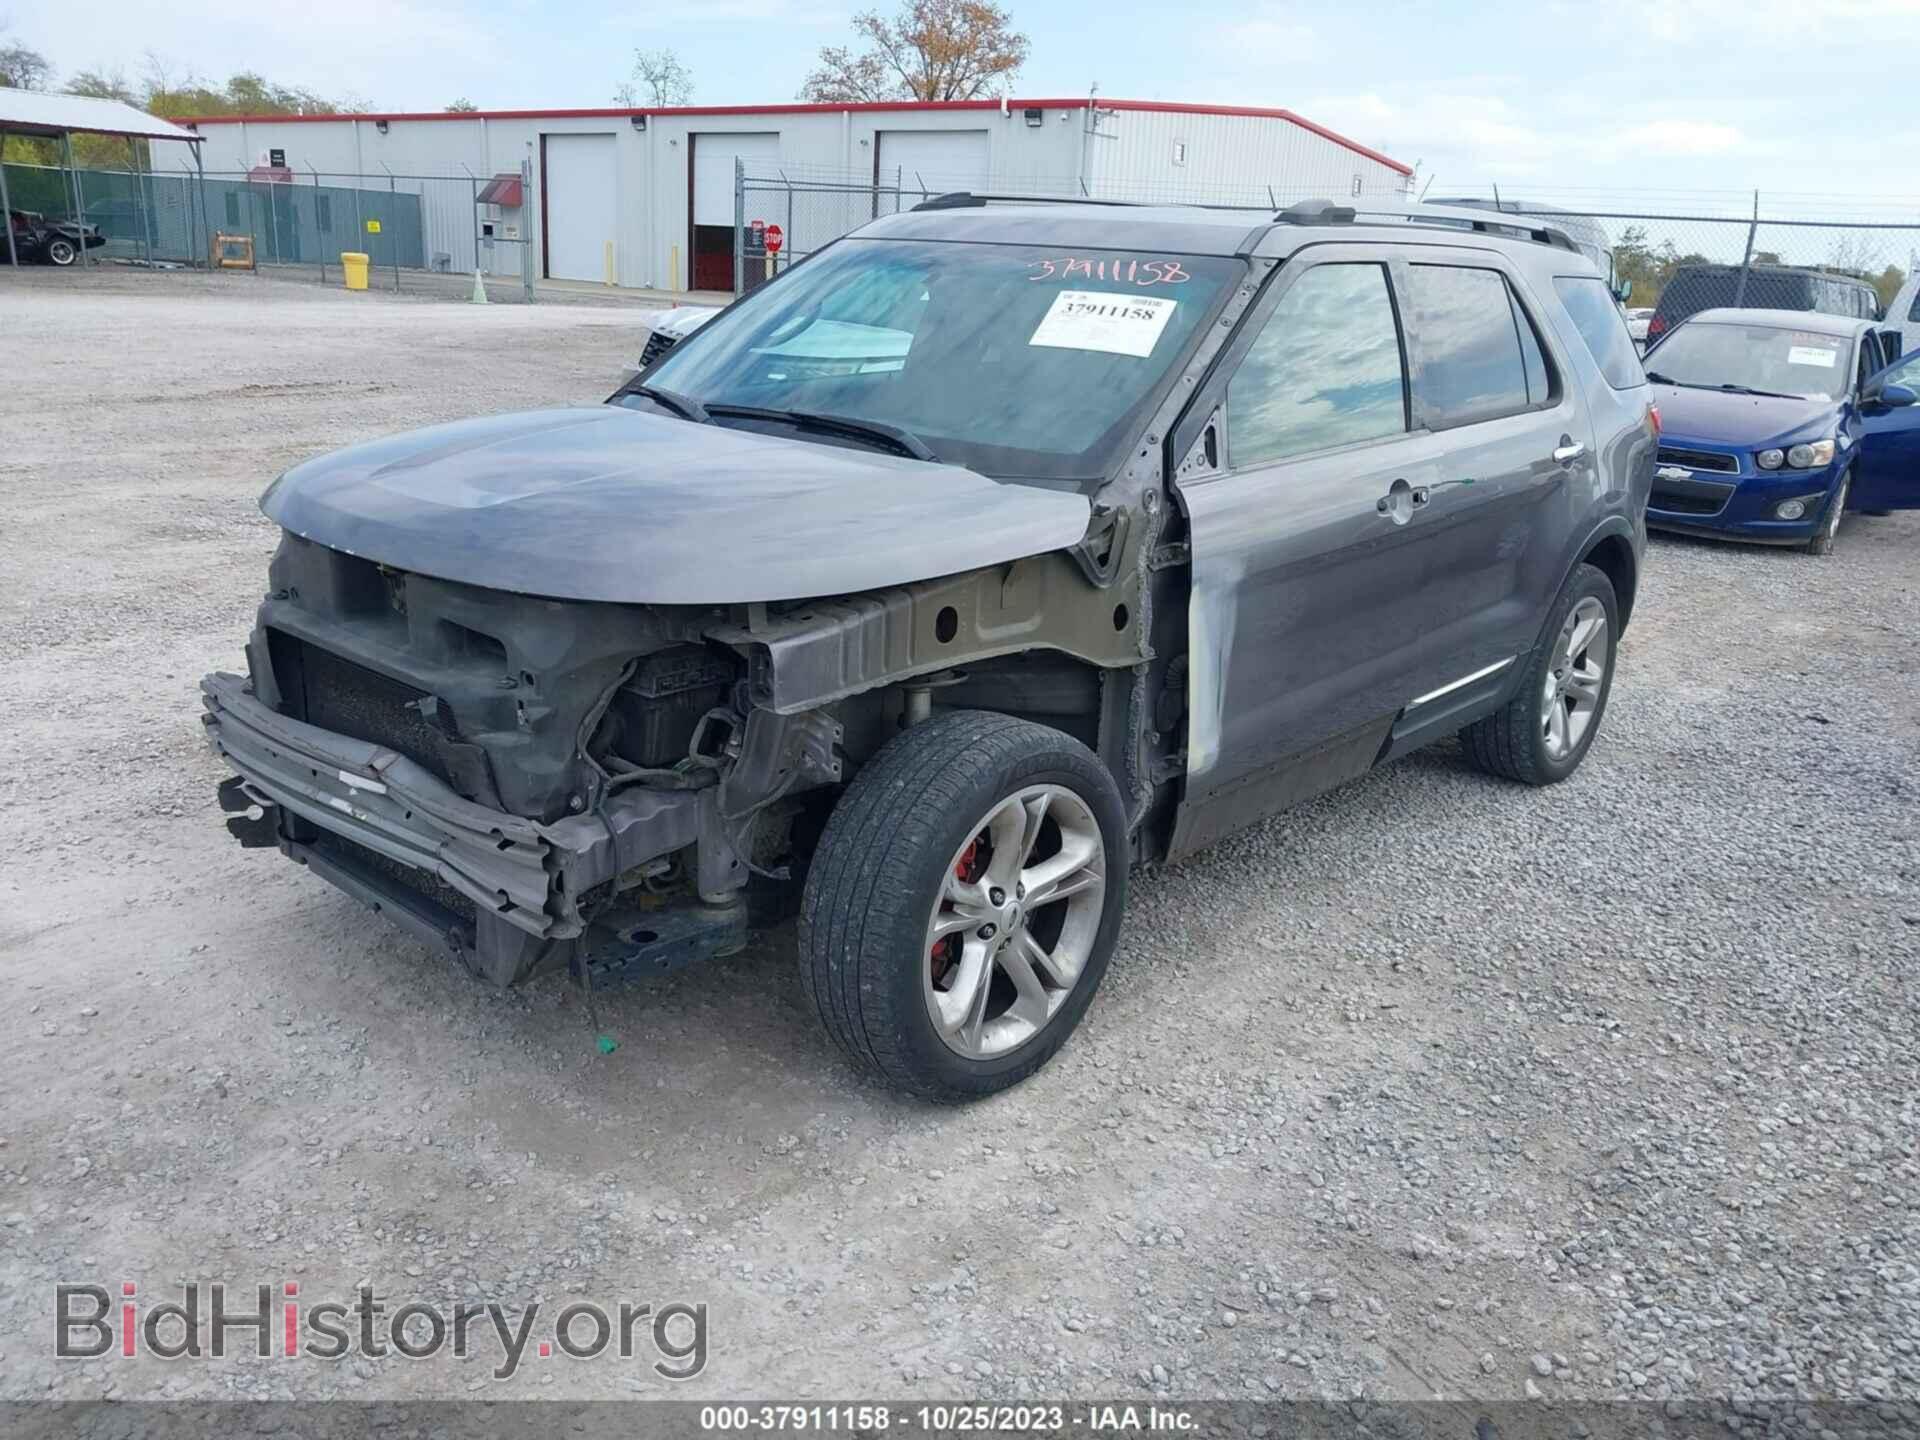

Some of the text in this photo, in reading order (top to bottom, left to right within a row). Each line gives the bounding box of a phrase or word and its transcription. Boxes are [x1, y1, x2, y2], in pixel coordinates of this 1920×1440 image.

[766, 232, 783, 244] STOP
[1027, 257, 1191, 286] 37911158
[1061, 303, 1156, 320] 37911158
